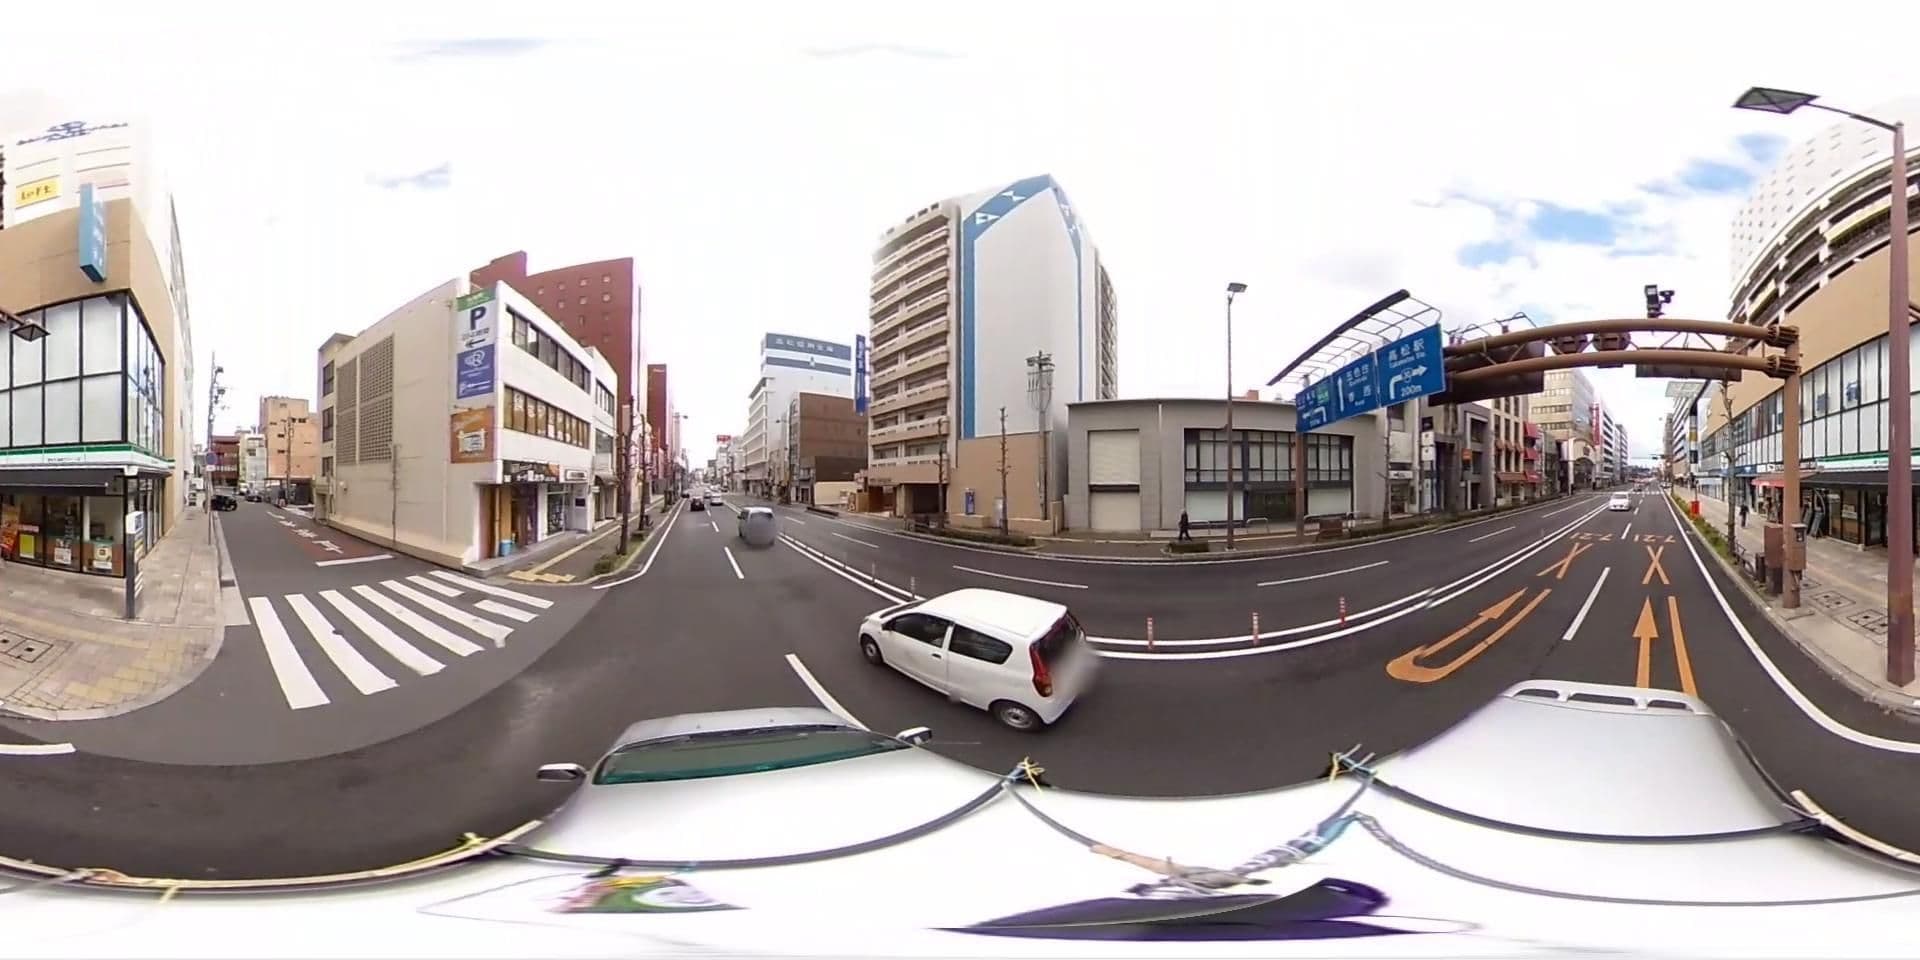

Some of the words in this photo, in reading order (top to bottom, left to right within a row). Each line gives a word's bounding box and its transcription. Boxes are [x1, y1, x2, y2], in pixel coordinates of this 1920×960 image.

[470, 306, 487, 330] P
[1389, 338, 1424, 361] 高松駅
